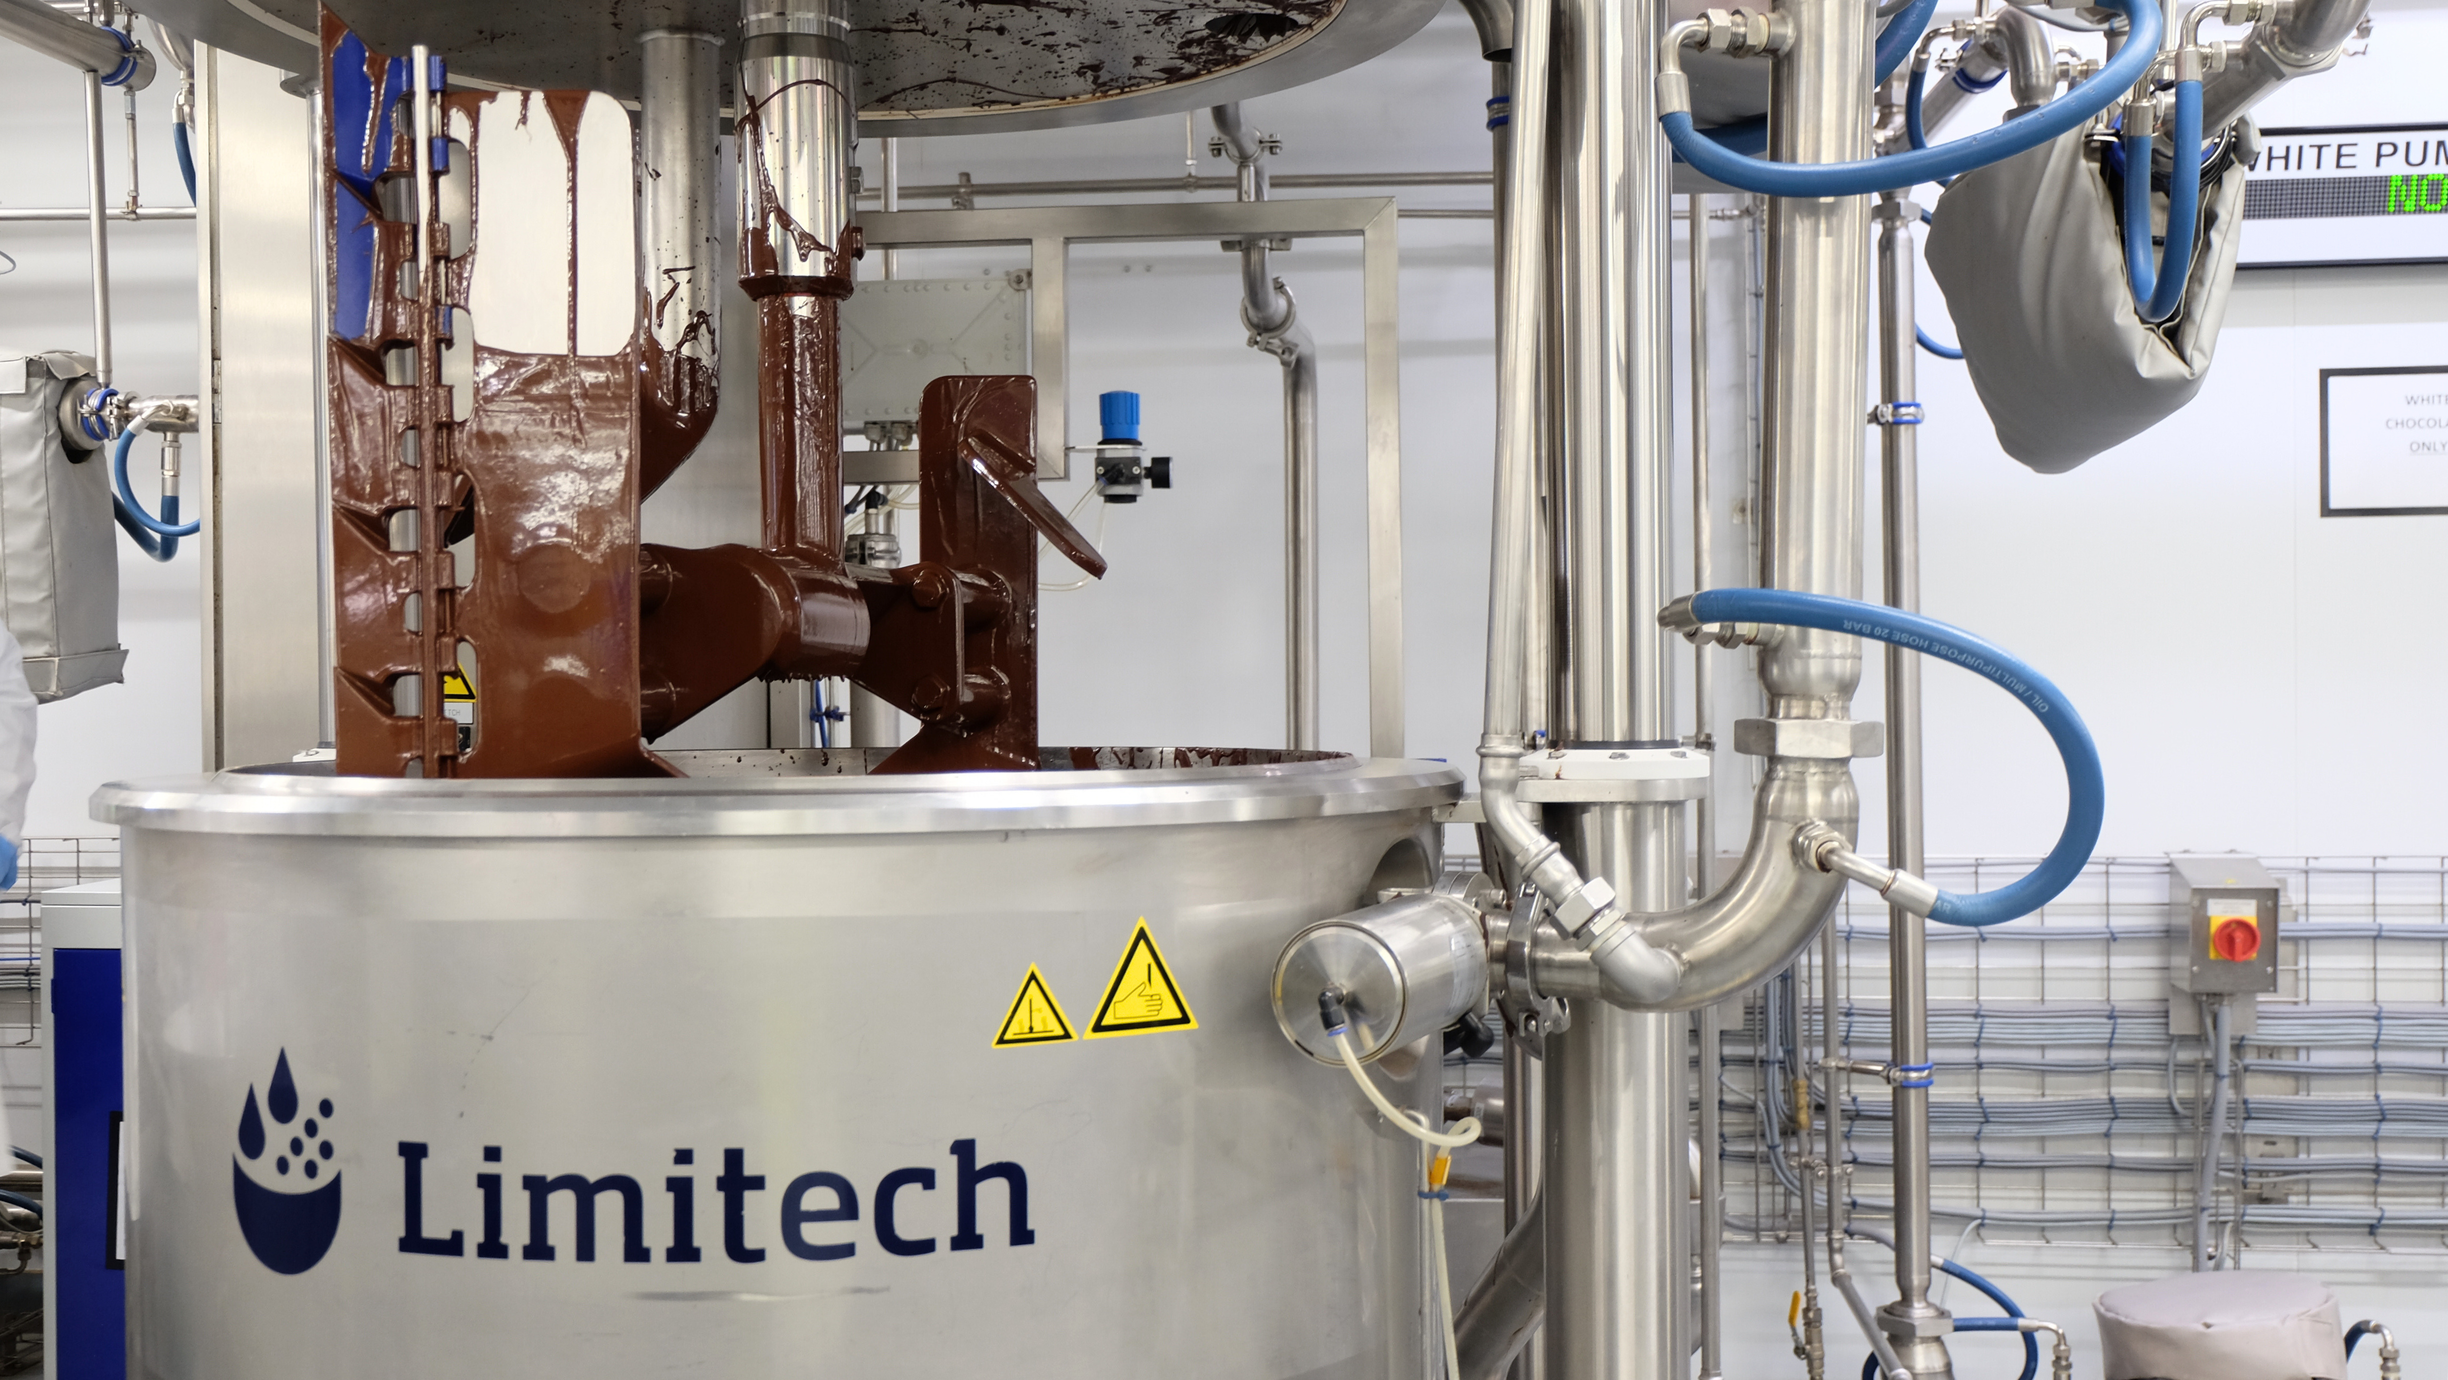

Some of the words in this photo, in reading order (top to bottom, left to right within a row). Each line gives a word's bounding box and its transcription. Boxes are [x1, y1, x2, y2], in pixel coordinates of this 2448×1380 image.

[2388, 173, 2448, 213] NO
[2409, 440, 2448, 453] ONLY
[1842, 619, 1872, 634] BAR
[1874, 626, 1889, 638] 20
[1891, 630, 1929, 649] HOSE
[1930, 642, 2027, 694] MULTIPURPOSE
[2031, 694, 2049, 713] OIL
[398, 1138, 1035, 1264] Limitech
